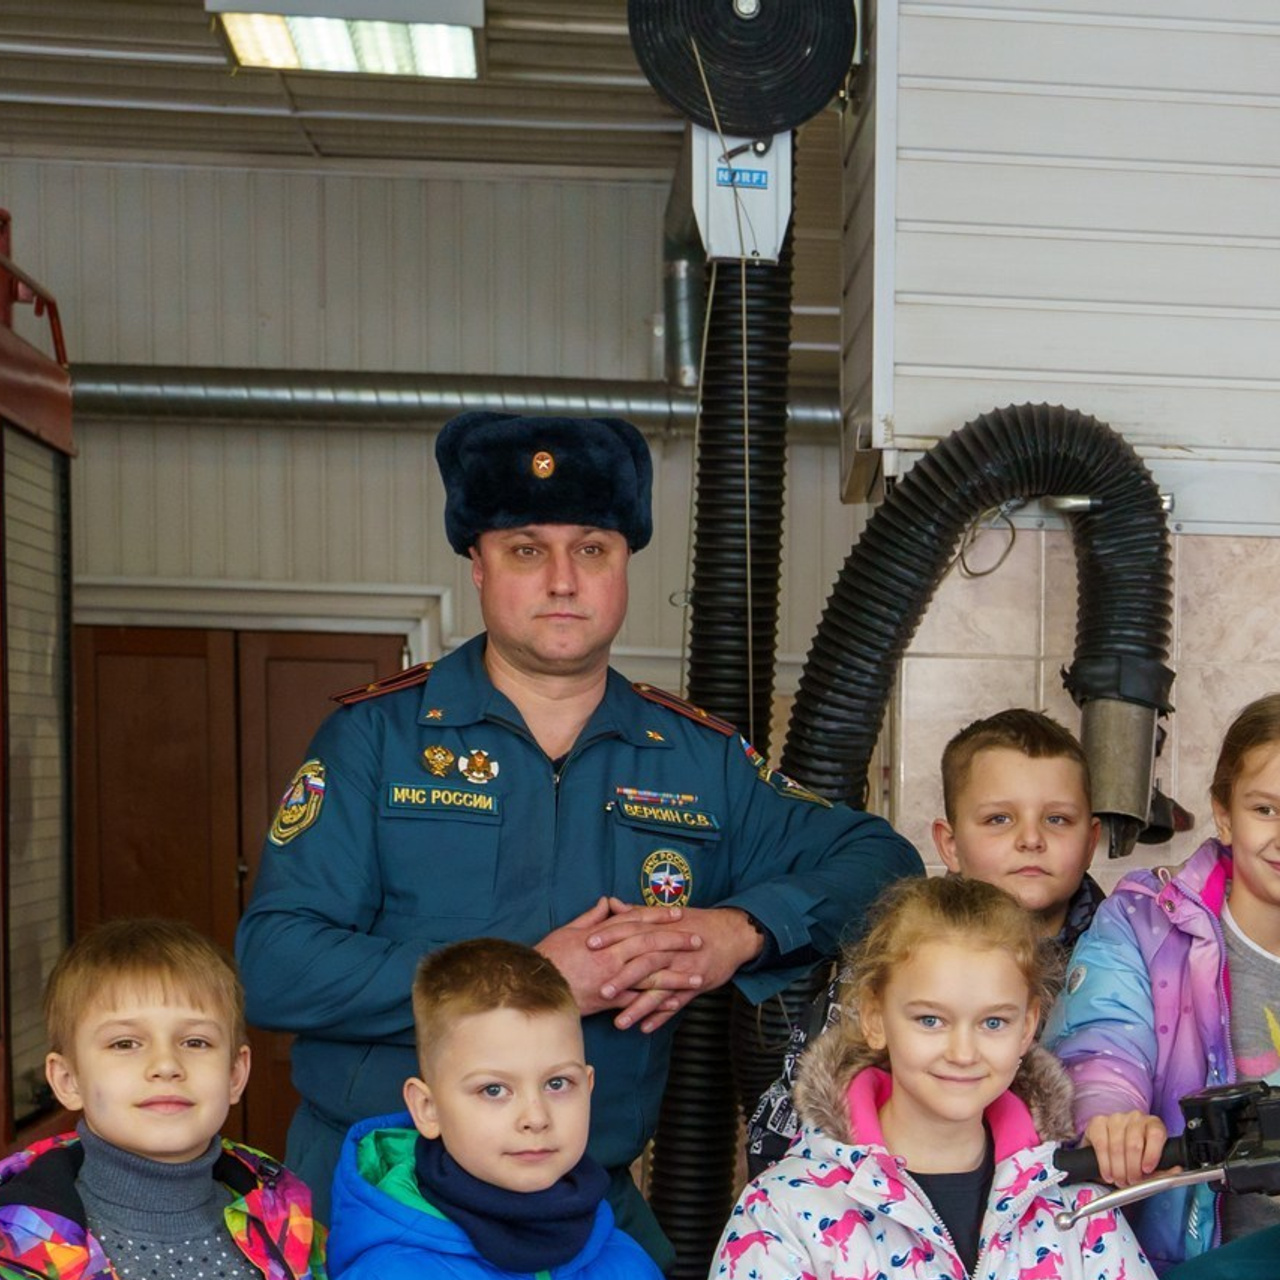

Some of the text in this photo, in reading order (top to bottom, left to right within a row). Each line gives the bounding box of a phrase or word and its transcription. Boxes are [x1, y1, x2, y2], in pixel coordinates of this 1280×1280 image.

[394, 787, 493, 811] МЧС РОССИИ
[624, 803, 682, 823] ВЕРКИН
